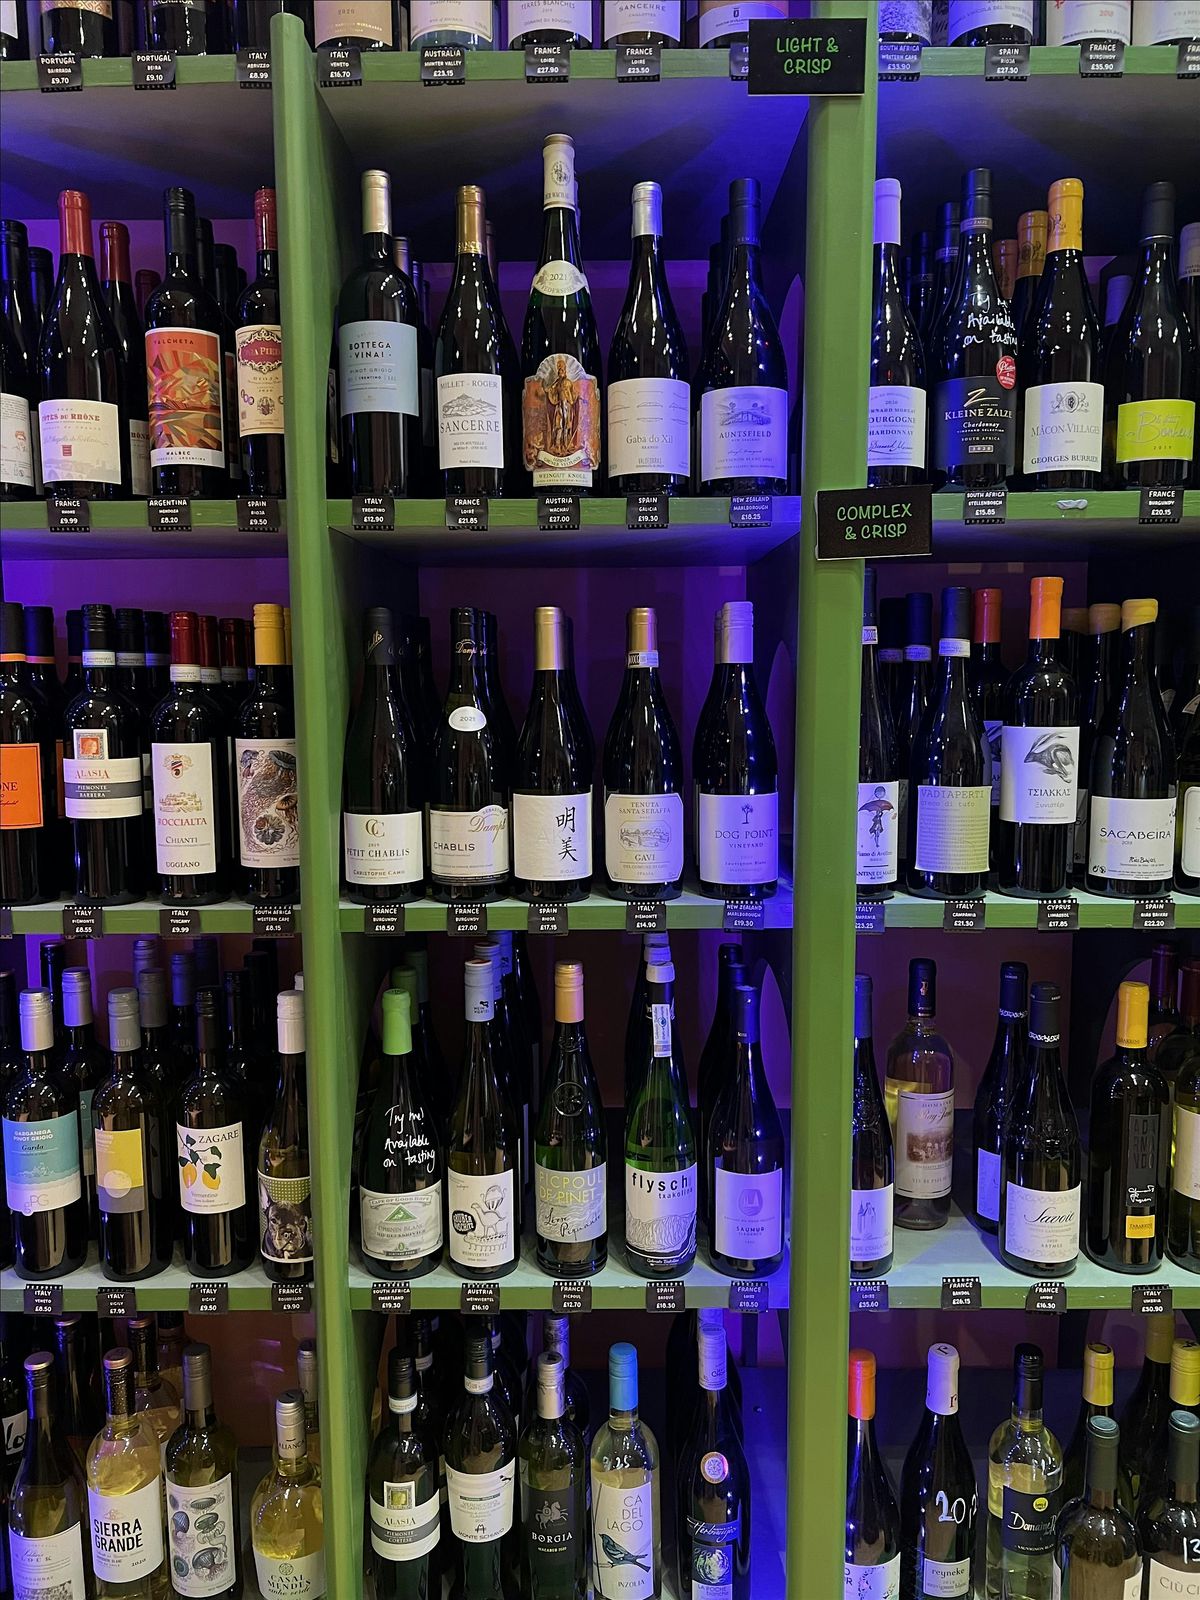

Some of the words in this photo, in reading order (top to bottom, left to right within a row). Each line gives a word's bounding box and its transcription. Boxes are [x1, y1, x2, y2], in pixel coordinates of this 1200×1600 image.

[618, 4, 666, 12] SANCERRE
[777, 37, 822, 53] LIGHT
[826, 38, 839, 53] &
[1089, 44, 1115, 52] FRANCE
[424, 50, 461, 58] AUSTRALIA
[534, 47, 561, 55] FRANCE
[626, 48, 653, 56] FRANCE
[41, 57, 76, 65] PORTUGAL
[784, 58, 831, 74] CRISP
[549, 272, 567, 281] 2021
[349, 341, 391, 350] BOTTEGA
[440, 380, 464, 389] MILLET
[472, 380, 498, 388] ROGER
[945, 409, 984, 420] KLEINE
[986, 407, 1012, 418] ZALZE
[440, 420, 499, 434] SANCERRE
[963, 421, 1000, 429] Chardonnay
[626, 434, 647, 444] Gaba
[649, 434, 659, 443] do
[1031, 455, 1069, 465] GEORGES
[538, 471, 565, 480] WEINGUT
[567, 471, 587, 479] KNOLL
[1149, 490, 1175, 498] FRANCE
[837, 503, 912, 521] COMPLEX
[845, 526, 857, 540] &
[861, 522, 907, 539] CRISP
[75, 769, 110, 780] ALASIA
[921, 789, 984, 798] VADIAPERTI
[157, 817, 207, 826] ROCCIALTA
[556, 806, 578, 862] 明美
[715, 830, 740, 839] DOG
[745, 828, 774, 839] POINT
[1099, 827, 1171, 839] SACABEIRA
[433, 841, 475, 852] CHABLIS
[346, 848, 364, 858] PETIT
[369, 849, 410, 858] CHABLIS
[385, 1104, 404, 1134] Try
[409, 1107, 424, 1126] me!
[198, 1129, 239, 1144] ZAGARE
[384, 1134, 430, 1154] Available
[383, 1158, 397, 1168] on
[405, 1149, 436, 1174] tasting
[539, 1170, 602, 1189] PICPOUL
[632, 1173, 688, 1194] flysch
[540, 1187, 552, 1199] DE
[557, 1189, 596, 1203] PINET
[658, 1187, 693, 1199] txakolina
[1024, 1206, 1075, 1224] Savoie
[624, 1494, 643, 1508] CA
[622, 1506, 643, 1520] DEL
[383, 1517, 416, 1526] ALASIA
[606, 1518, 644, 1533] LAGO
[94, 1518, 142, 1537] SIERRA
[458, 1530, 478, 1540] MONTE
[531, 1531, 573, 1544] BORGIA
[95, 1532, 143, 1553] GRANDE
[271, 1574, 305, 1583] CASAL
[931, 1567, 965, 1582] reyneke
[267, 1580, 311, 1590] MENDES
[618, 1579, 645, 1588] INZOLIA
[1159, 1576, 1183, 1592] CIÙ
